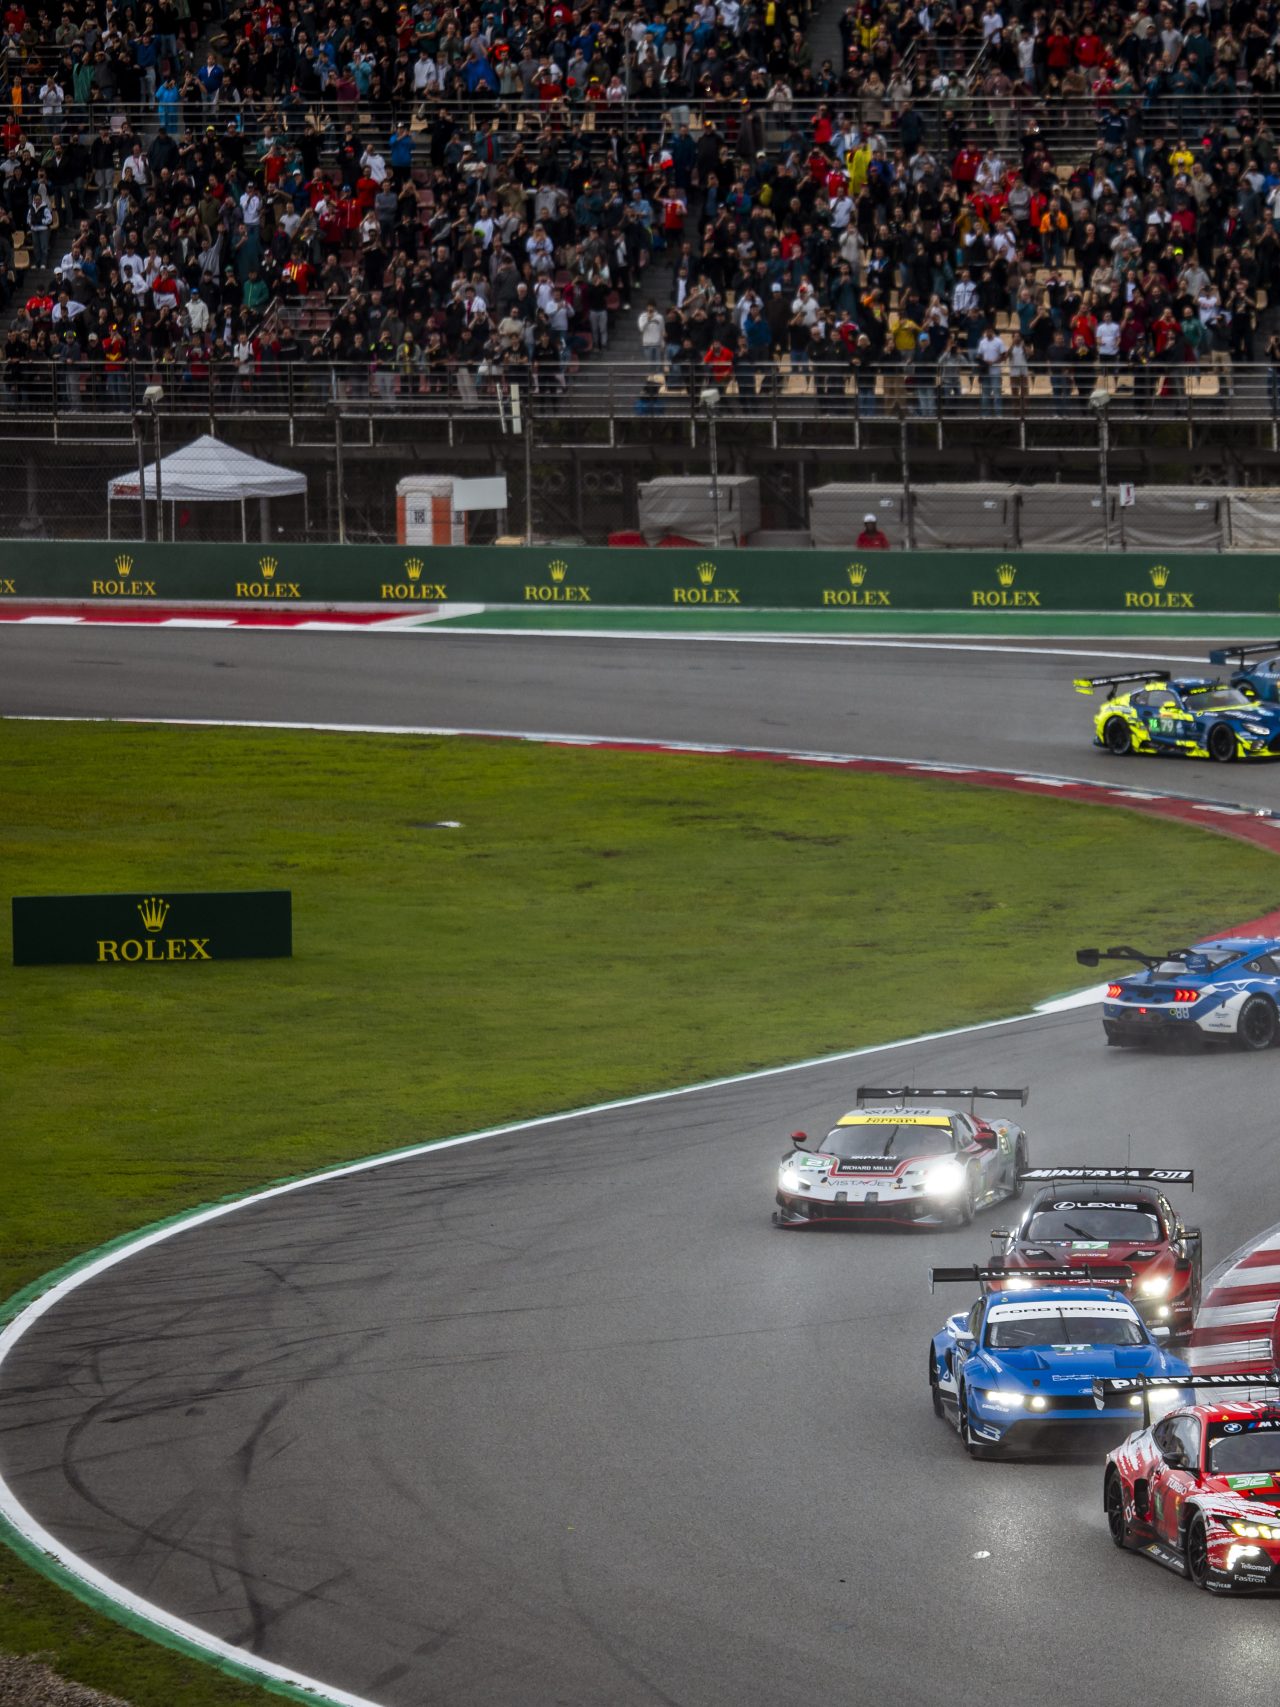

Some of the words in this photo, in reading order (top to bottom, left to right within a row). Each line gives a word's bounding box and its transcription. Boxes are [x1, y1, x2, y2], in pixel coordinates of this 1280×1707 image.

[92, 580, 157, 596] ROLEX
[235, 582, 301, 598] ROLEX
[381, 583, 448, 600] ROLEX
[524, 585, 590, 601] ROLEX
[673, 587, 739, 604] ROLEX
[822, 588, 890, 605] ROLEX
[972, 590, 1040, 606] ROLEX
[1125, 591, 1193, 608] ROLEX
[1161, 719, 1174, 732] 79
[96, 939, 212, 962] ROLEX
[1175, 1007, 1190, 1019] 88
[1020, 1169, 1140, 1178] MINERVA
[1077, 1202, 1138, 1210] LEXUS
[995, 1307, 1051, 1316] FORD
[1053, 1306, 1129, 1314] RACING
[1166, 1477, 1188, 1495] TURBO
[1240, 1562, 1271, 1572] Telkomsel
[1234, 1574, 1267, 1584] Fastron
